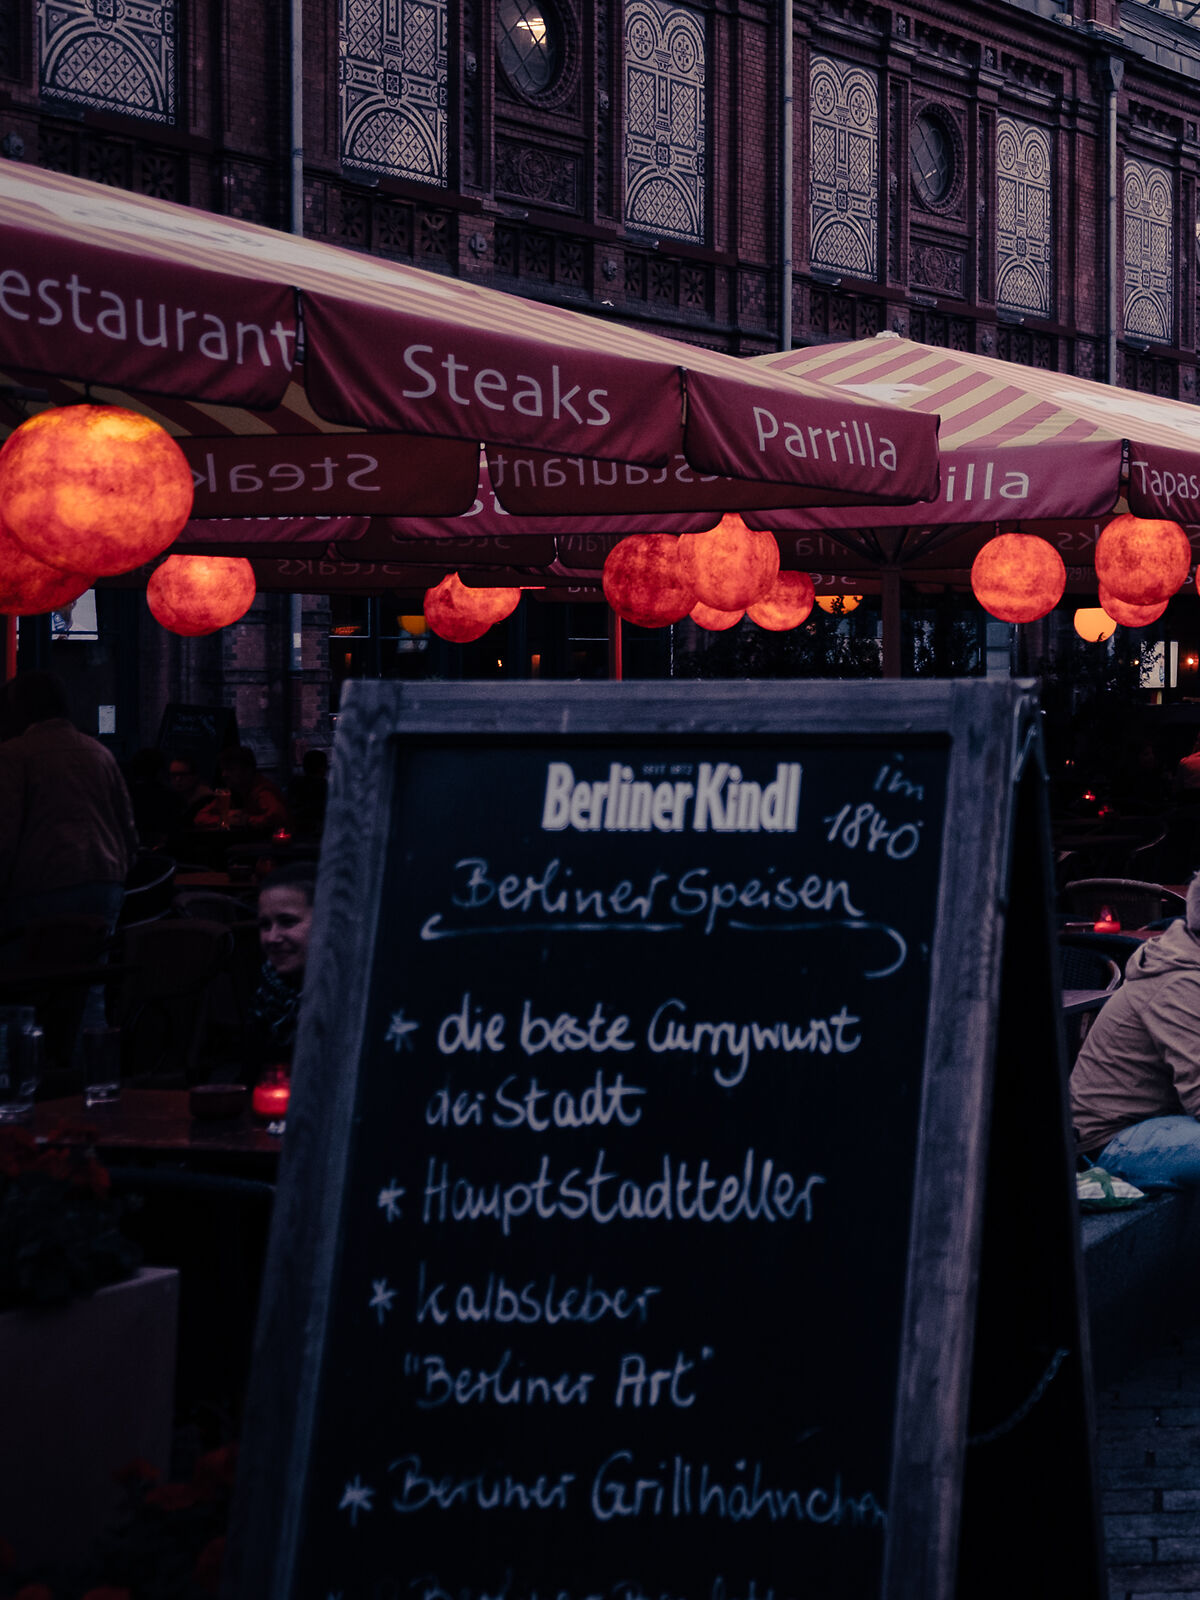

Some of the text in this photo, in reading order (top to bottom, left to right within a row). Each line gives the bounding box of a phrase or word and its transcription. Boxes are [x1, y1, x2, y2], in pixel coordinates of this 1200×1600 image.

[0, 268, 295, 372] estaurant
[400, 343, 612, 428] Steaks
[751, 405, 899, 472] Parrilla
[449, 858, 866, 935] Berliner Speisen
[435, 992, 862, 1088] die beste Currywurst
[492, 1070, 647, 1132] Stadt
